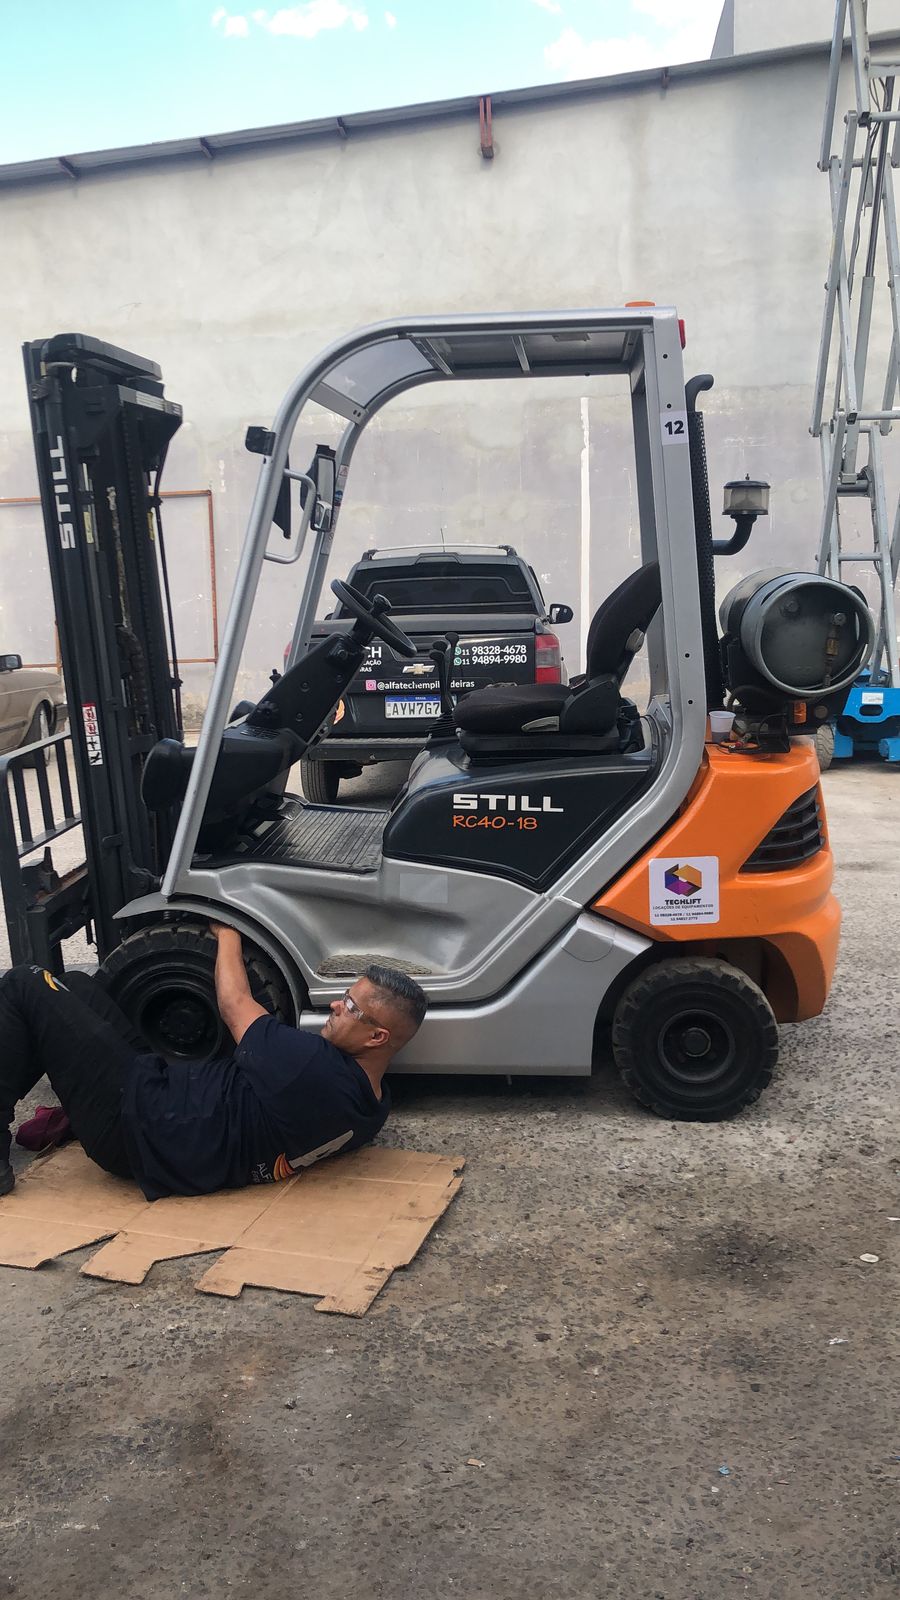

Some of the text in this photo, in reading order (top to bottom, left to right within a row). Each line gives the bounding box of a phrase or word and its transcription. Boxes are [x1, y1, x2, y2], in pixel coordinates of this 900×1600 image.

[664, 420, 685, 435] 12
[49, 435, 76, 549] STILL
[471, 645, 527, 655] 98328-4678
[471, 654, 527, 665] 94894-9980
[377, 680, 475, 691] @alfatechempildeiras
[392, 702, 440, 716] AYW7G7
[452, 793, 564, 812] STILL
[452, 815, 538, 830] RC40-18
